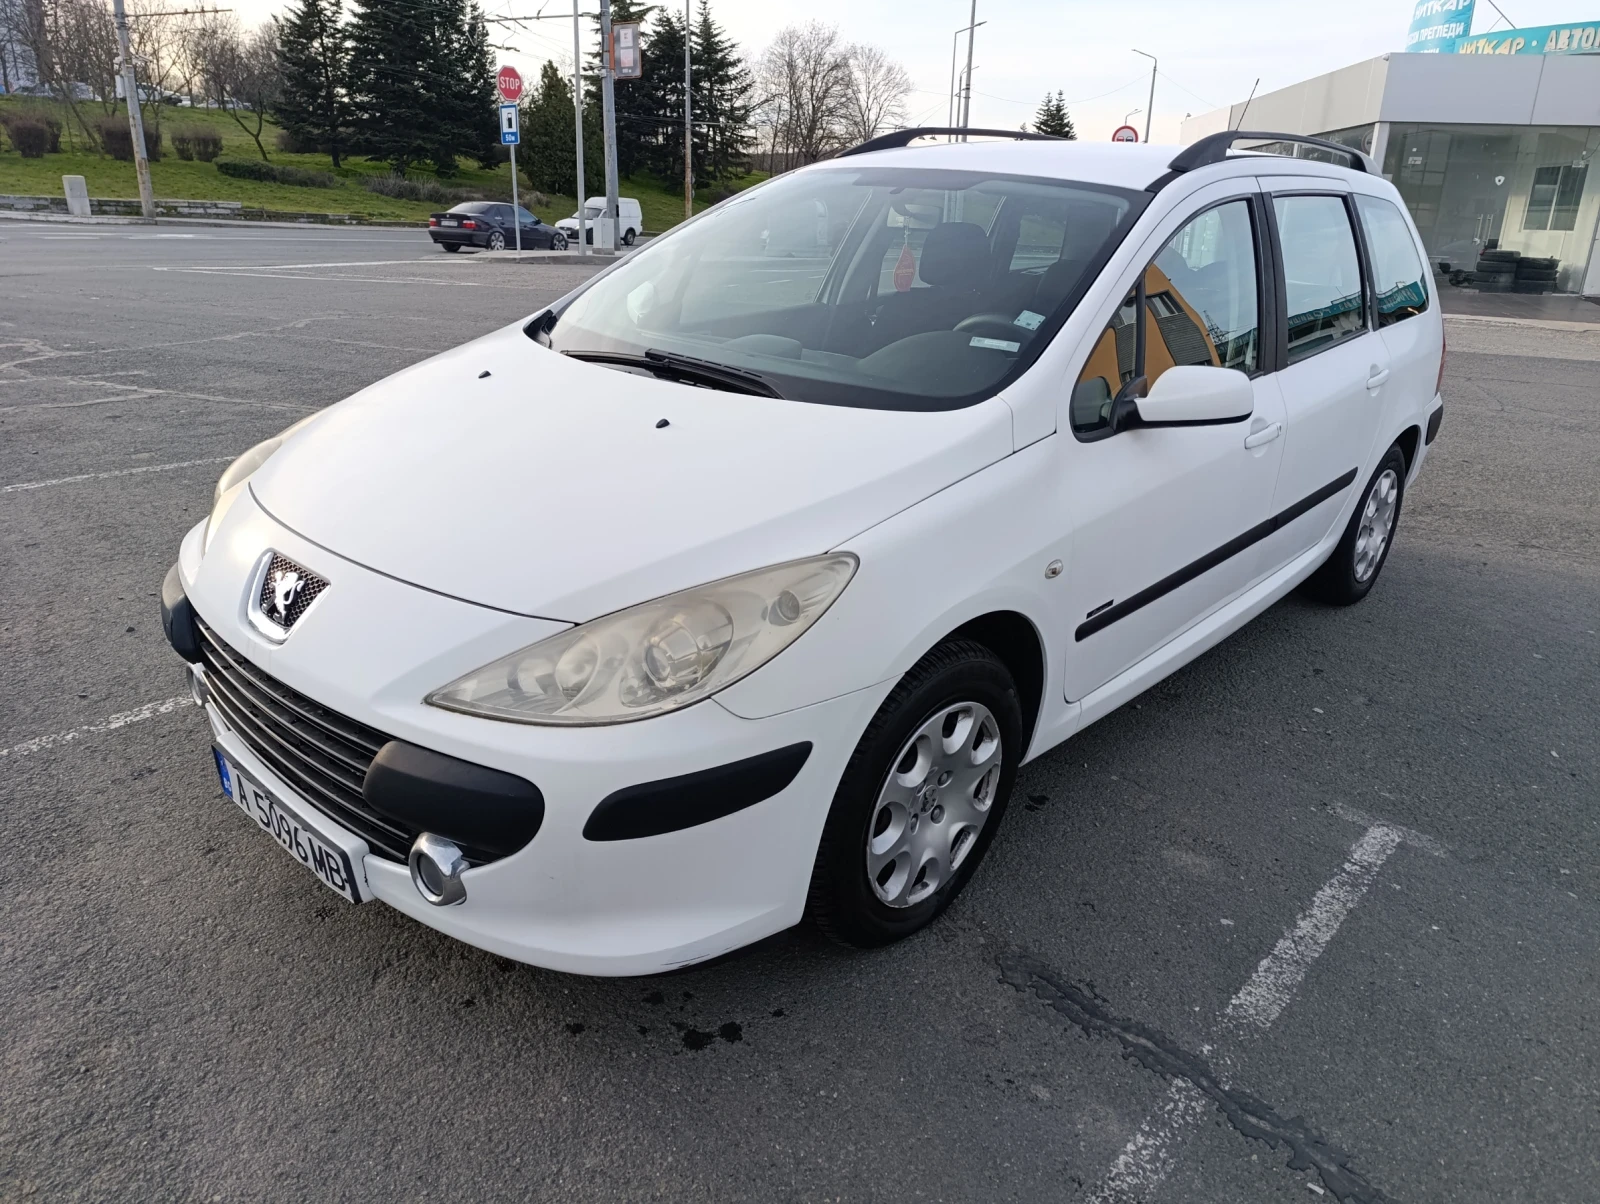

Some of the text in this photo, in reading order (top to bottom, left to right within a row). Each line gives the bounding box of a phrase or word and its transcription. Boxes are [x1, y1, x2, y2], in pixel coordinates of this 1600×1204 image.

[1420, 22, 1465, 41] ПРЕГЛЕДИ
[500, 77, 520, 90] STOP
[236, 773, 346, 892] A 5096 MB
